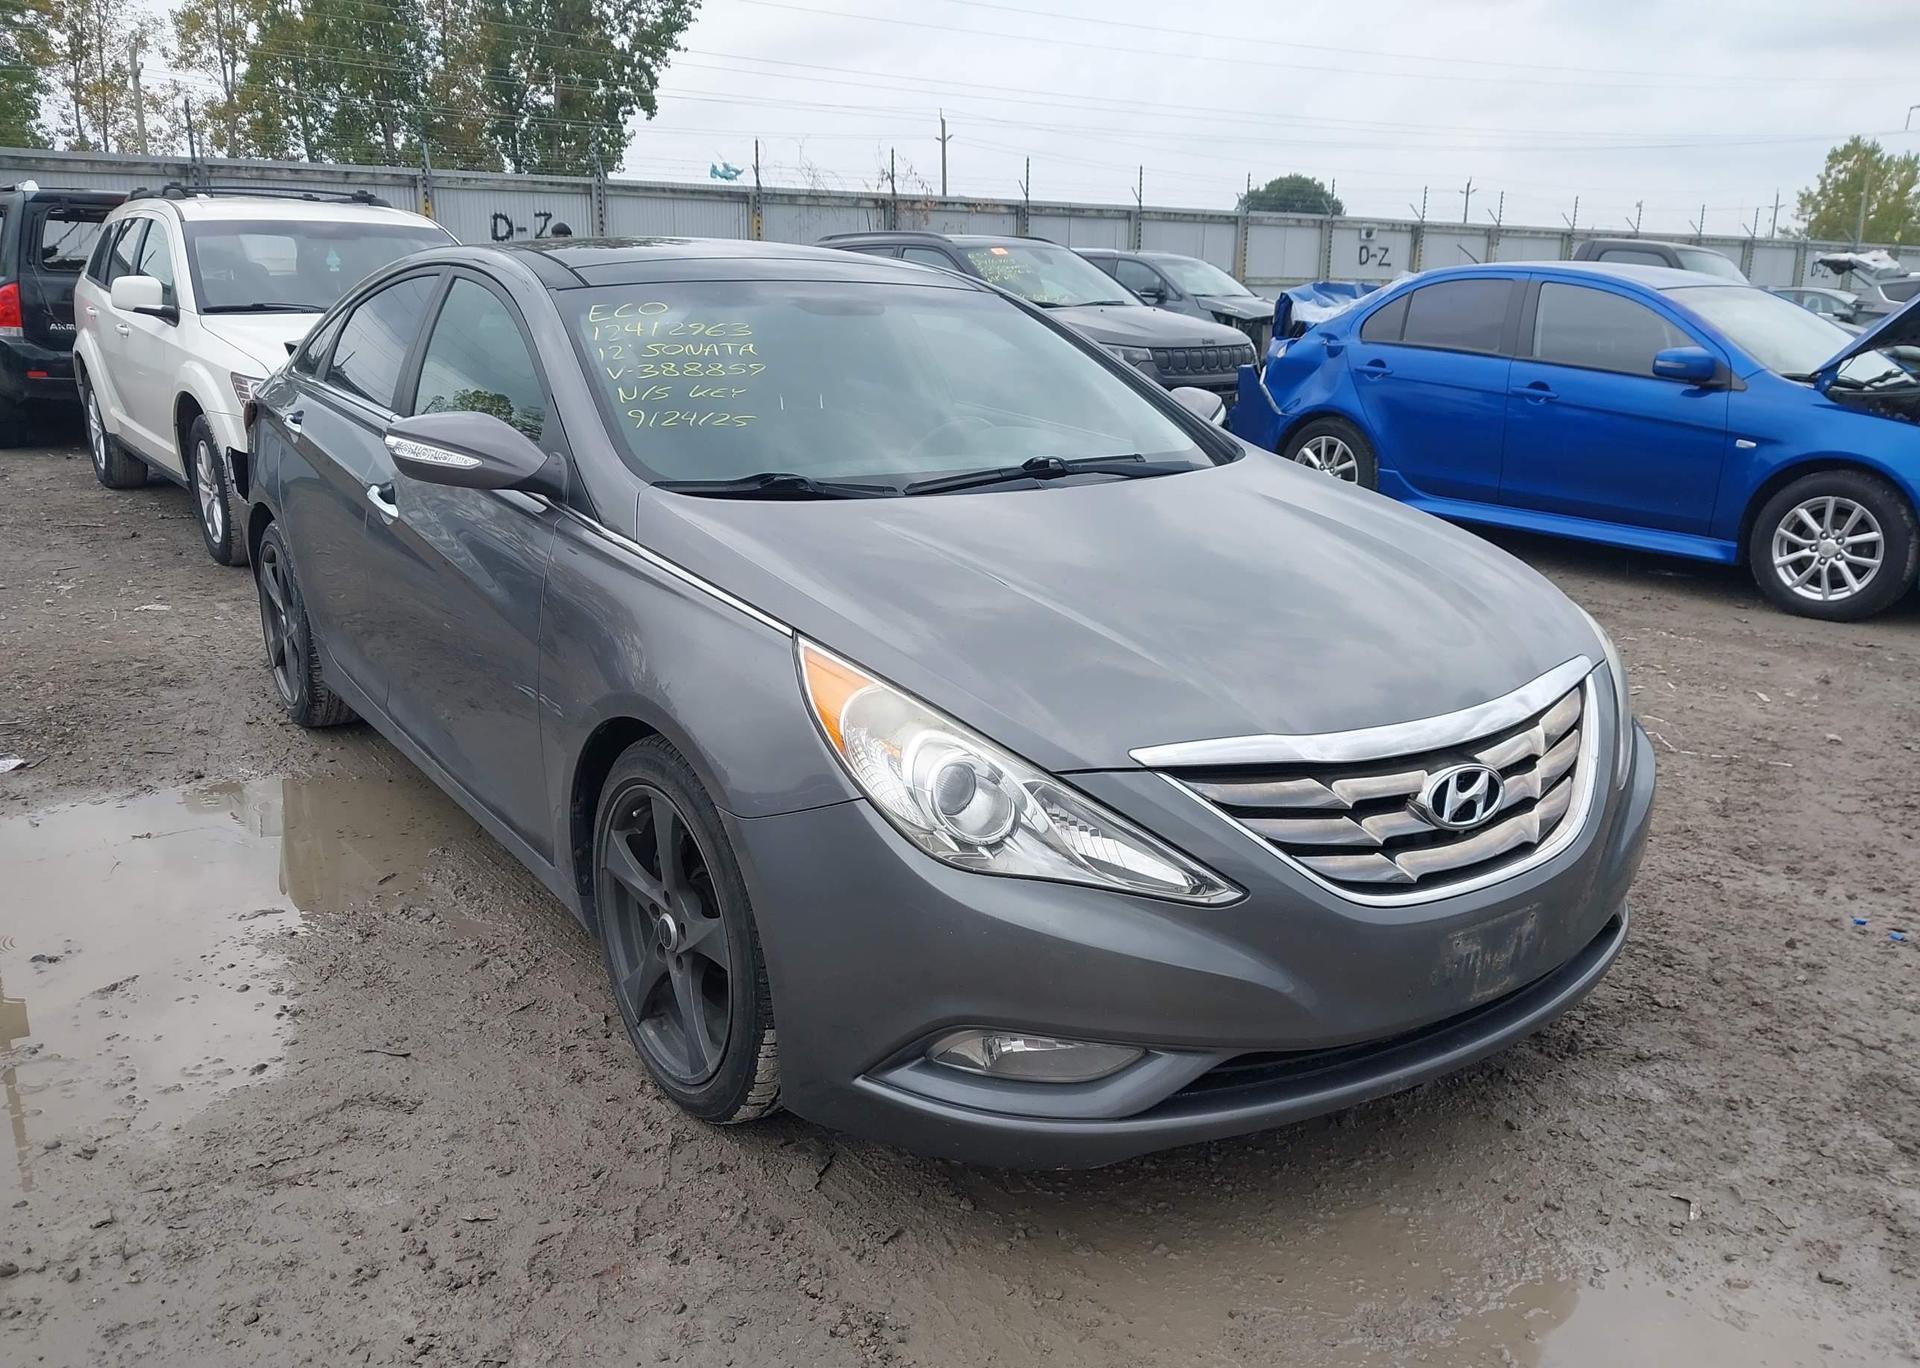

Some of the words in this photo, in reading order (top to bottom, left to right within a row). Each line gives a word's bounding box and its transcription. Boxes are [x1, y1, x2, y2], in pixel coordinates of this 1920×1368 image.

[1359, 245, 1391, 267] D-Z
[588, 302, 668, 322] ECO
[594, 321, 753, 341] 12412963
[641, 343, 759, 357] SONATA
[617, 385, 673, 403] N/S
[627, 409, 758, 429] 9/24/25
